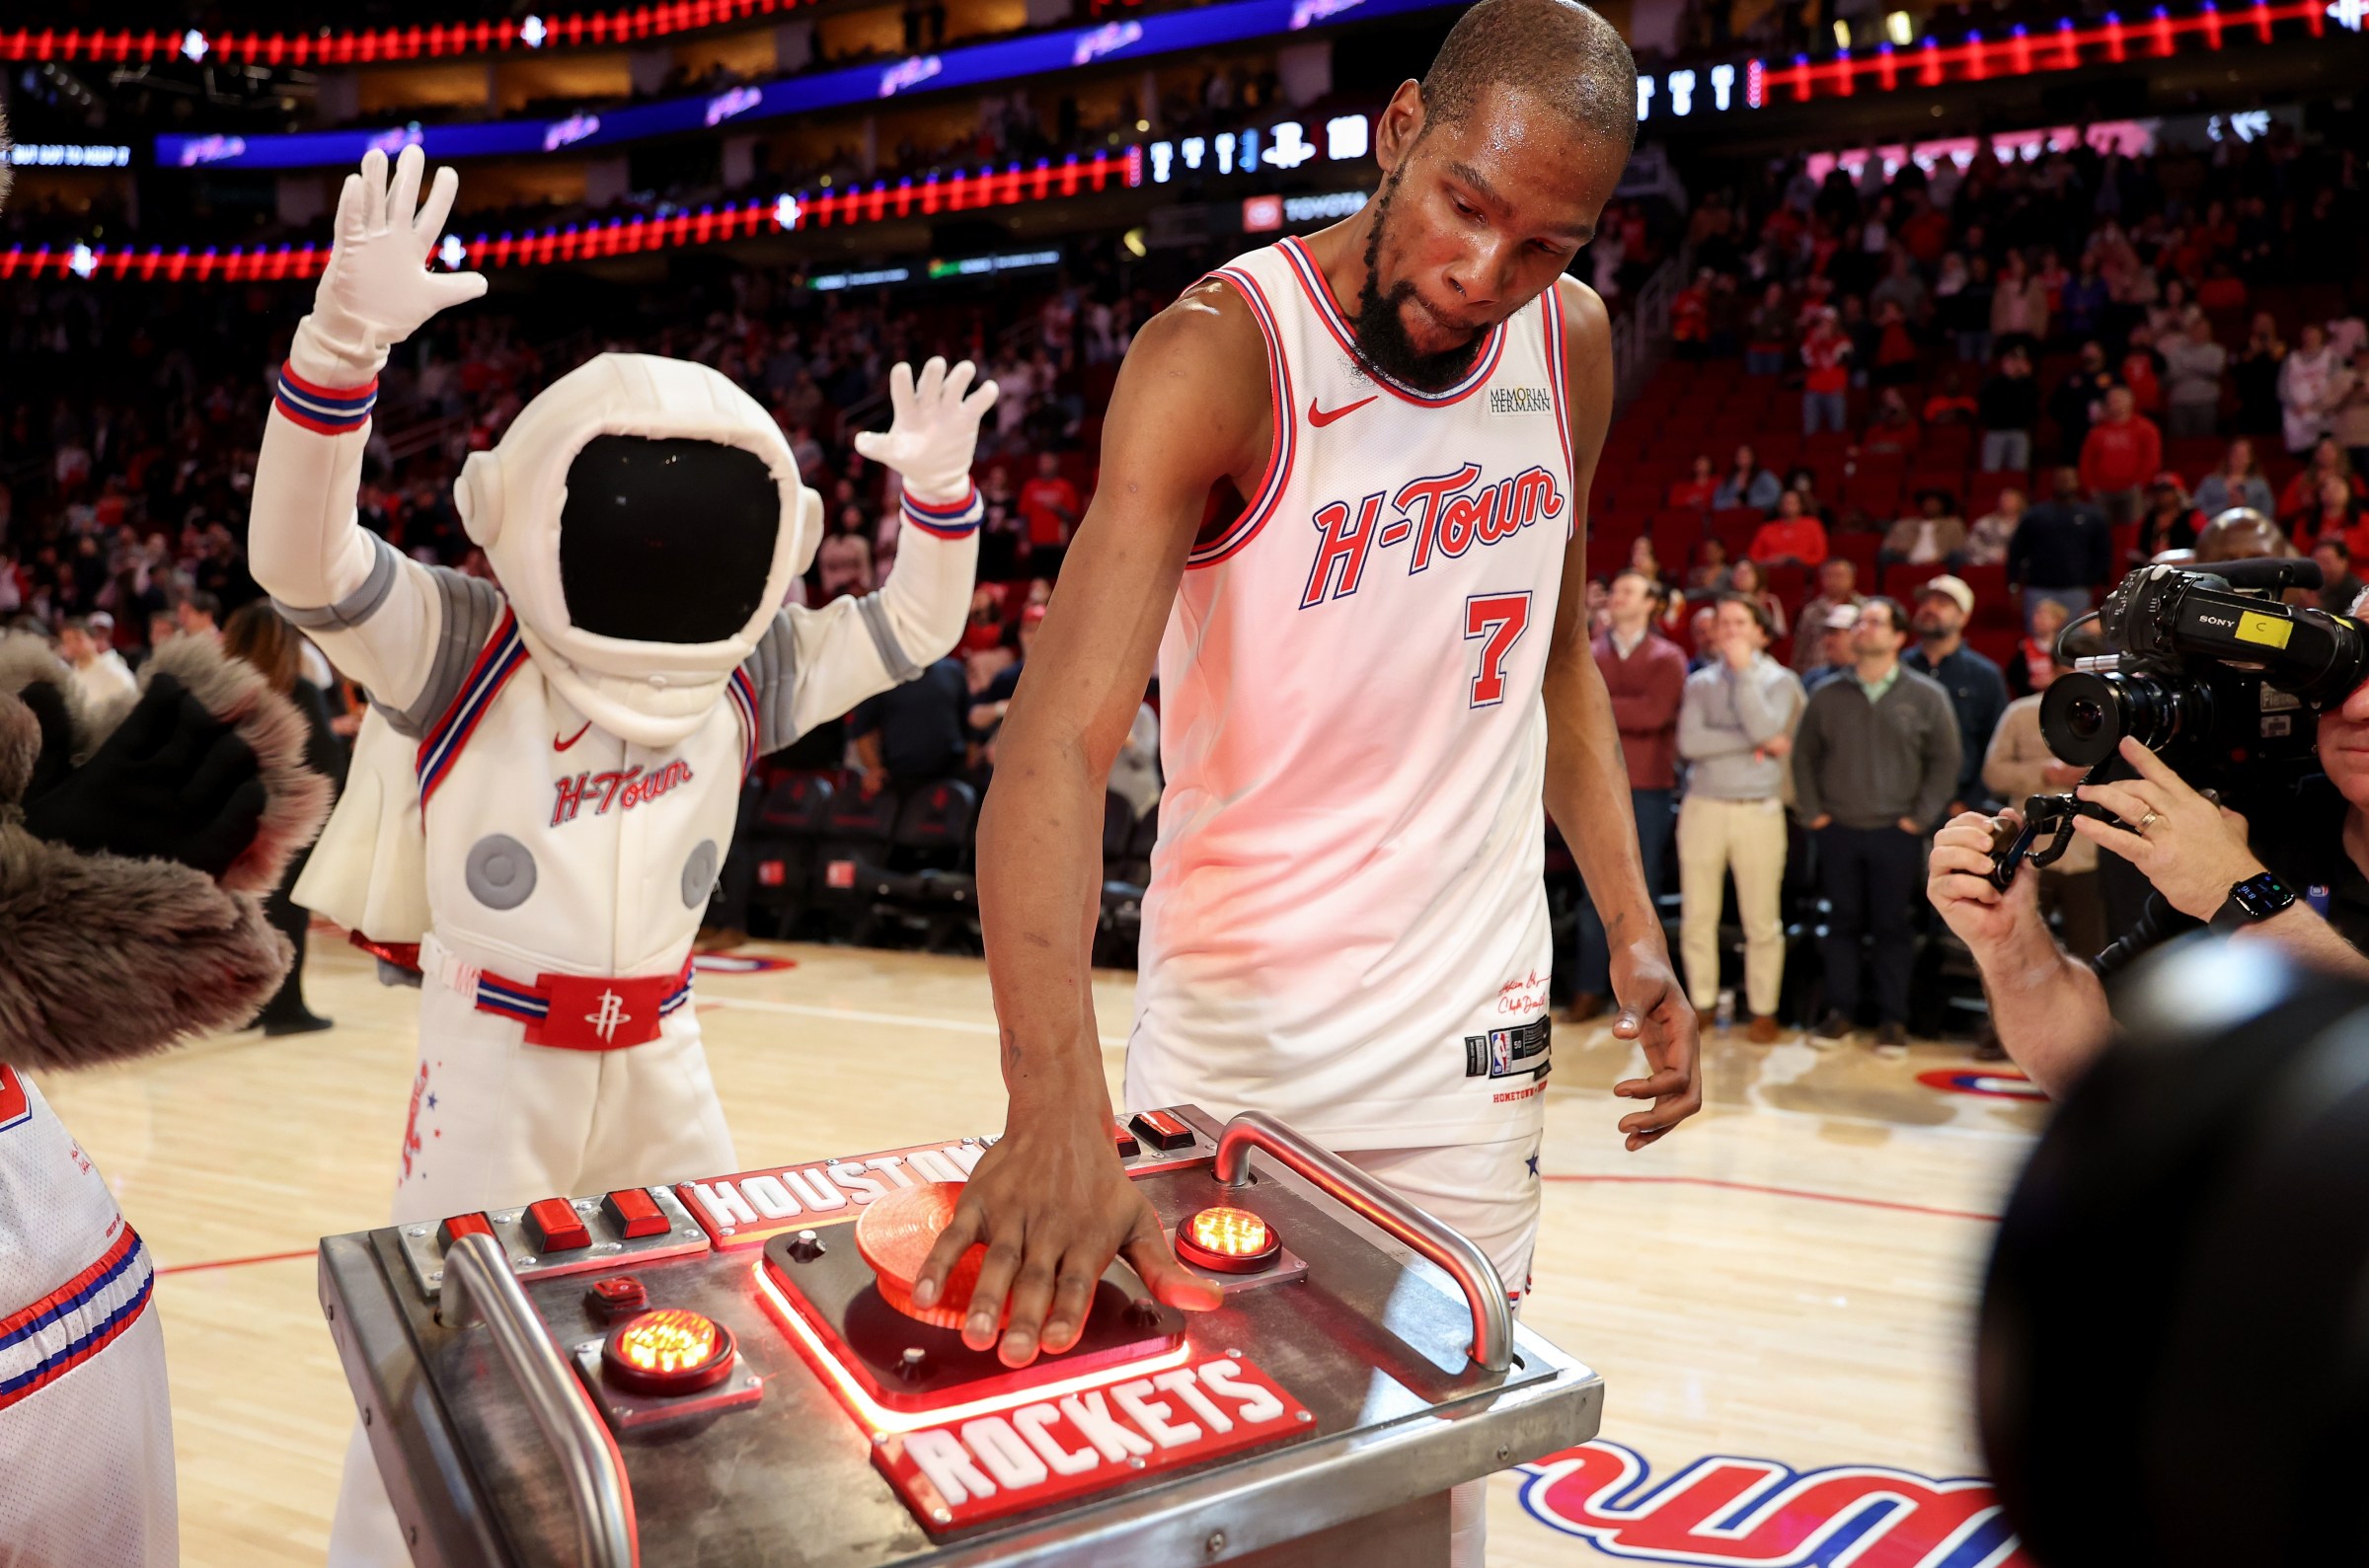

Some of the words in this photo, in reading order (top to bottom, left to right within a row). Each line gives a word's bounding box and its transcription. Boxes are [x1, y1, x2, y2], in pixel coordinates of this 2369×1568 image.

[1490, 387, 1551, 402] MEMORIAL
[1490, 399, 1551, 412] HERMANN
[1298, 462, 1566, 610] H-Town
[2198, 614, 2236, 629] SONY
[1464, 590, 1533, 709] 7
[550, 758, 694, 829] H-Town
[1492, 1086, 1534, 1103] HOMETOWN
[904, 1358, 1284, 1506] ROCKETS
